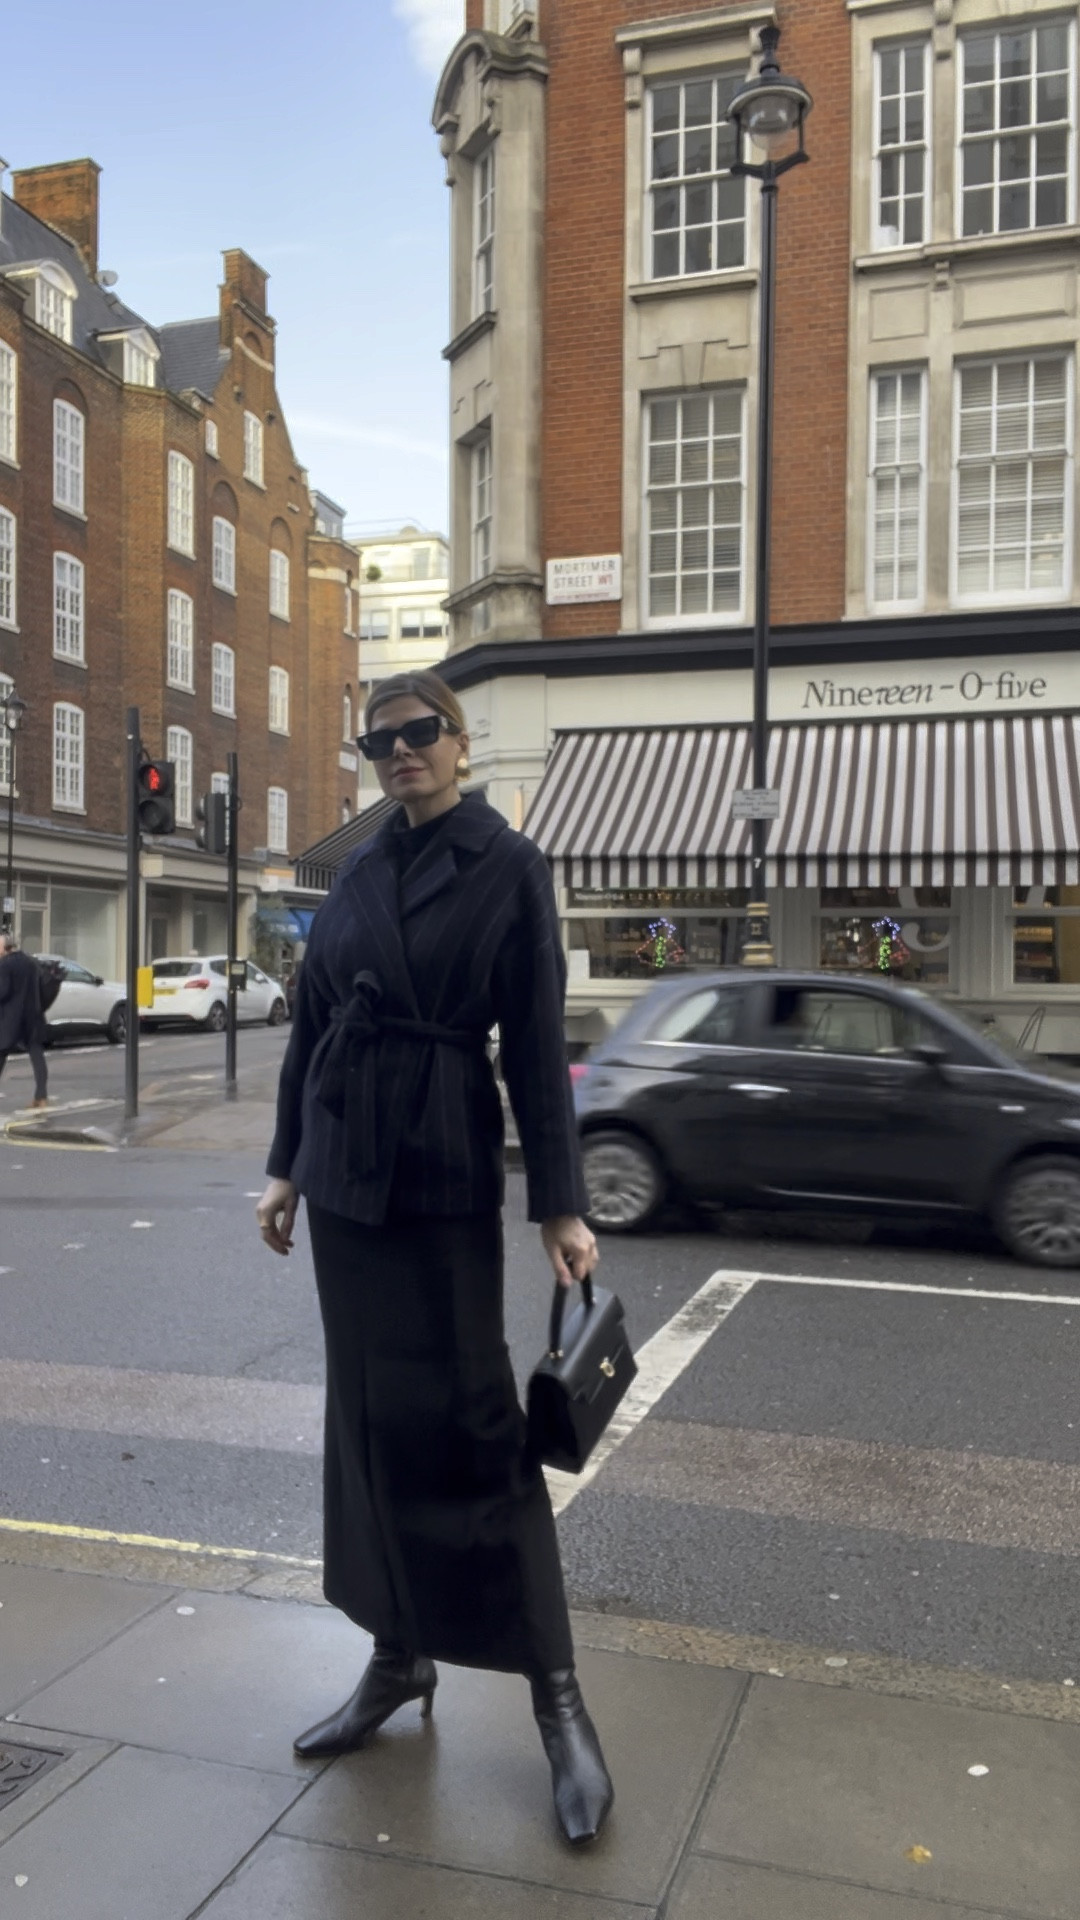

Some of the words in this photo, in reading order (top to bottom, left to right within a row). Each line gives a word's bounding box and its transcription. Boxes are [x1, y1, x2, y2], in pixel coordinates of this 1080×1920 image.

[554, 560, 615, 574] MORTIMER
[554, 575, 592, 588] STREET
[598, 573, 613, 585] W1
